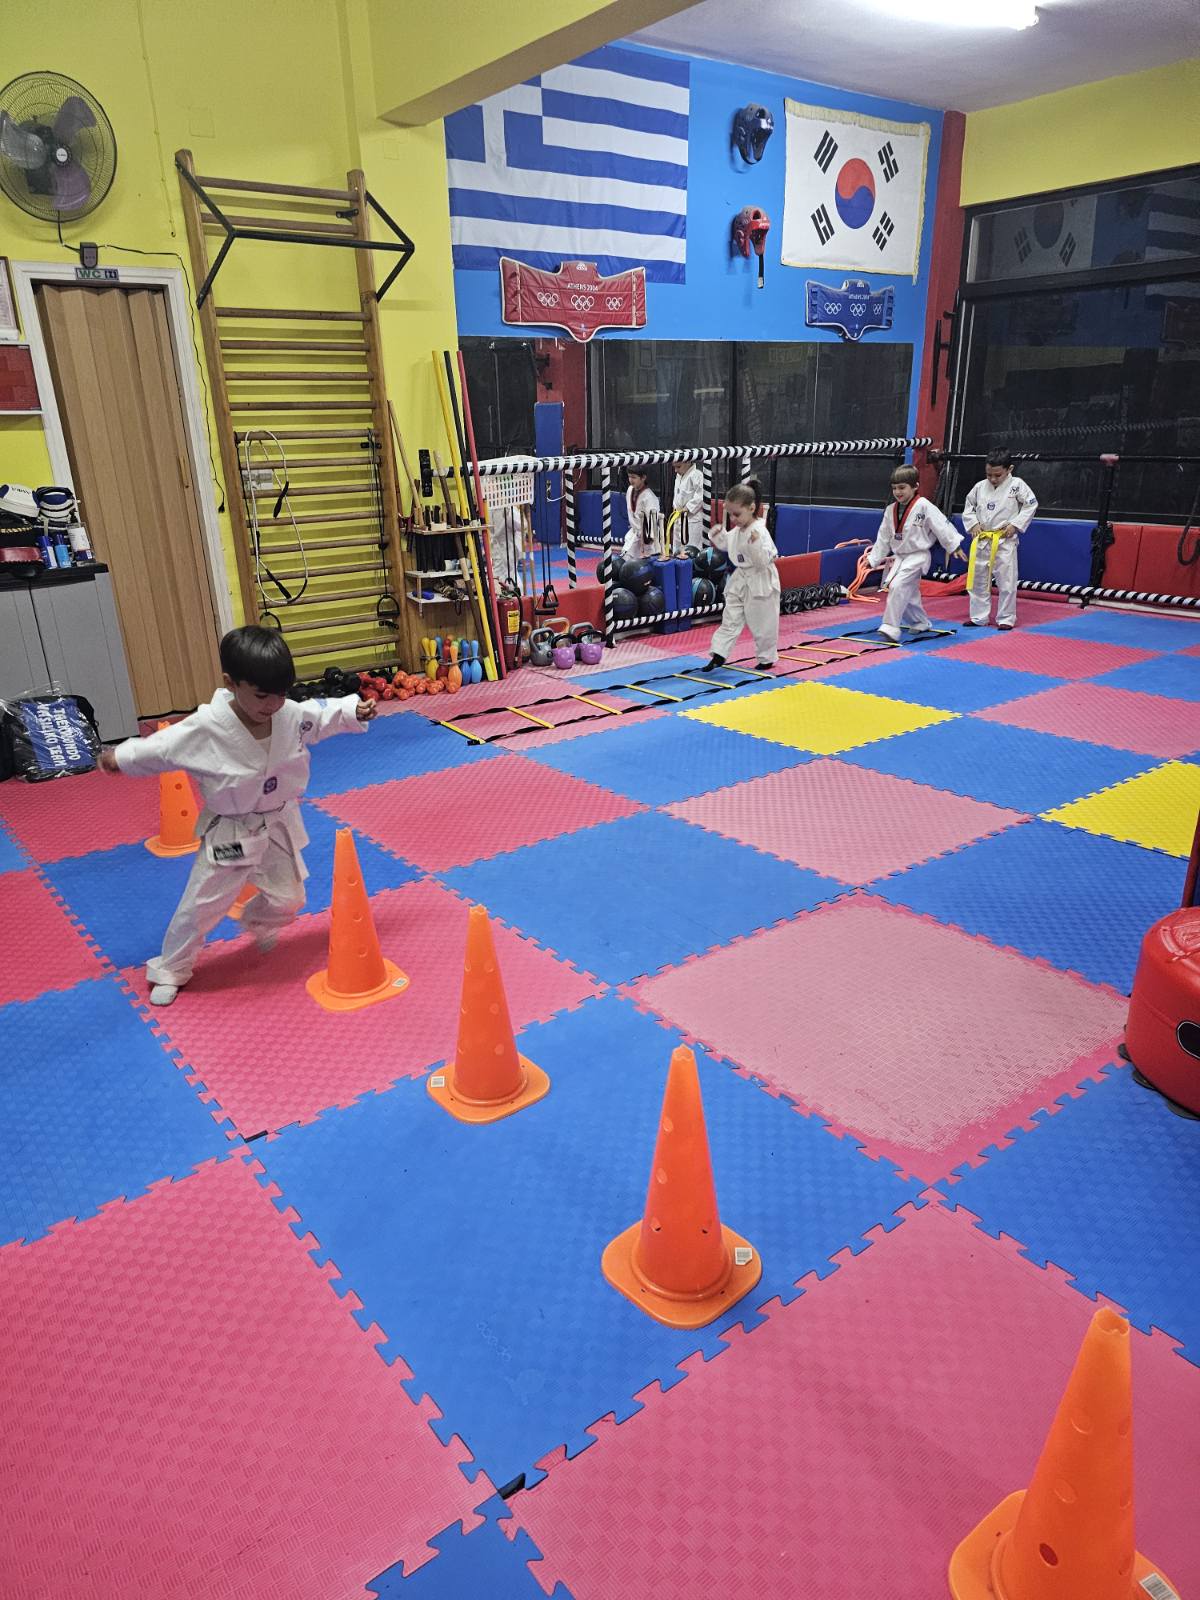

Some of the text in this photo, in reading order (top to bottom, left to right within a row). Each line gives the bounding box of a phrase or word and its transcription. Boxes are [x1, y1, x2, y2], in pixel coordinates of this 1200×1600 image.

[79, 270, 101, 278] WC
[54, 708, 80, 760] TAEKWONDO
[48, 745, 67, 766] TEAM
